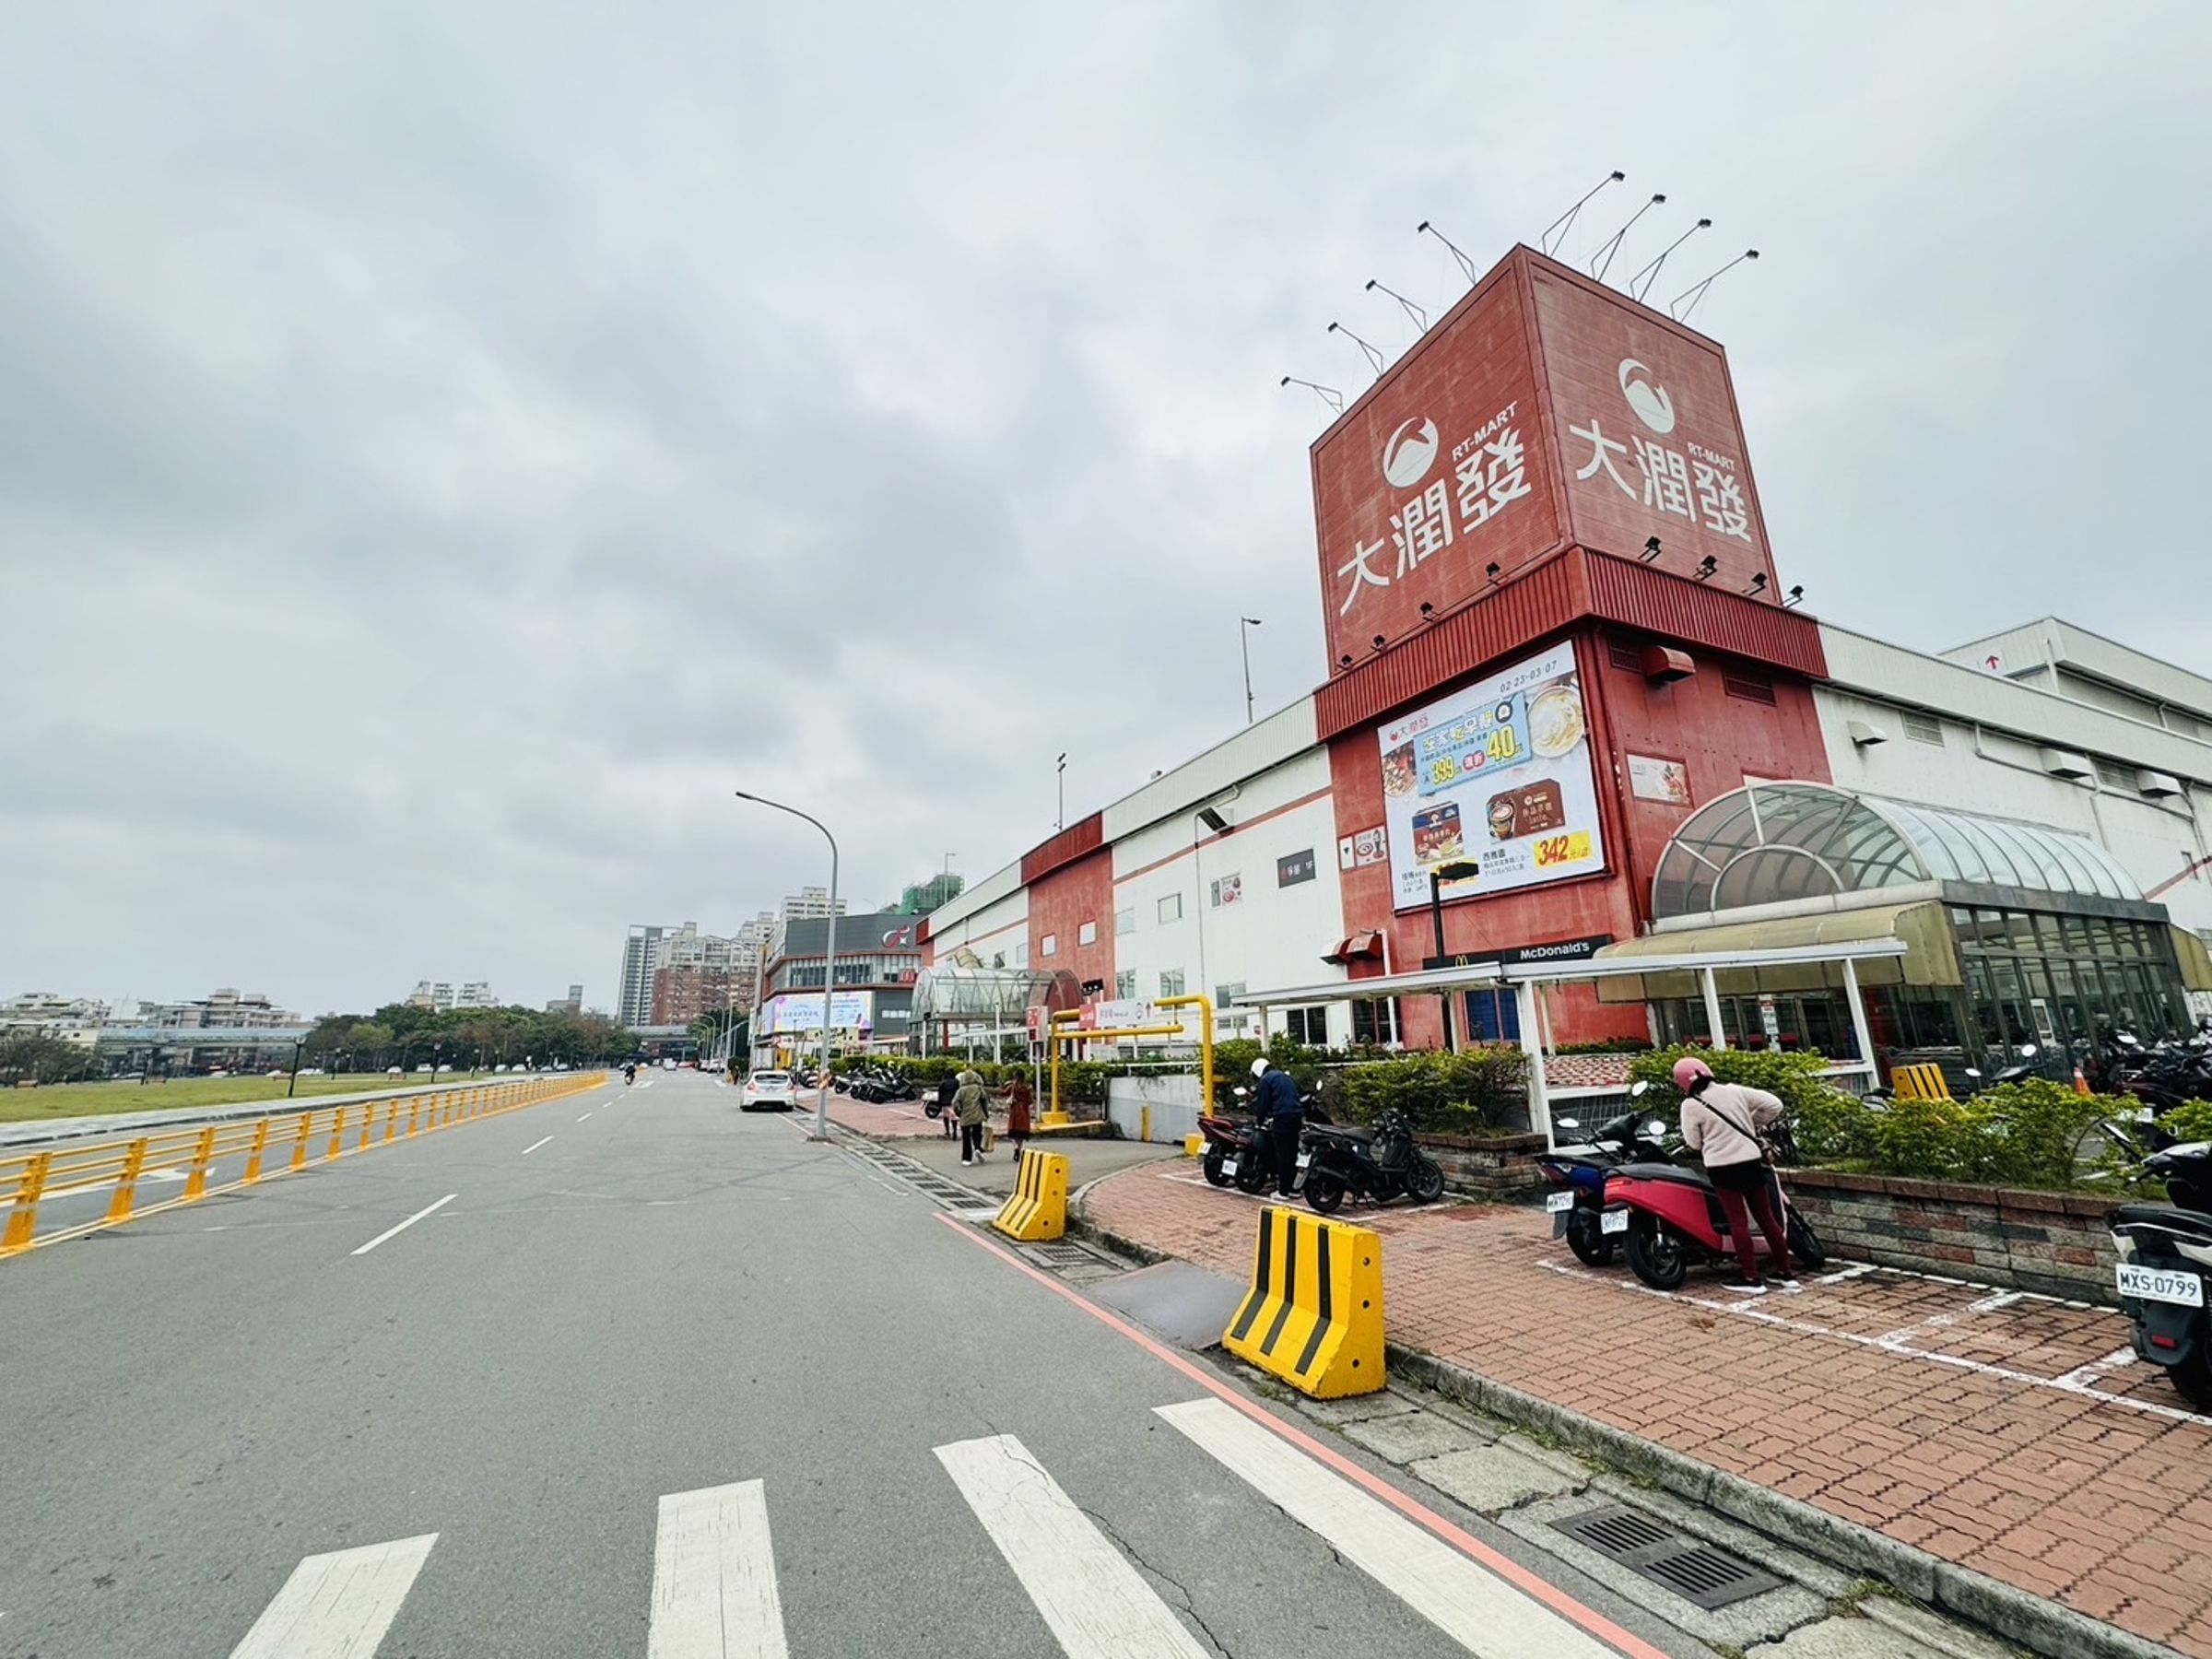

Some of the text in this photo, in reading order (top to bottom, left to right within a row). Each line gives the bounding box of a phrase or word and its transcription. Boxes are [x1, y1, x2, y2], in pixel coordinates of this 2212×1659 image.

[1452, 400, 1517, 462] RT-MART
[1688, 441, 1735, 471] RT-MART
[1569, 418, 1751, 543] 大潤發
[1336, 427, 1532, 617] 大潤發
[1487, 724, 1517, 762] 40
[1430, 754, 1456, 785] 399
[1537, 835, 1569, 865] 342
[1520, 942, 1590, 959] McDonald's
[2120, 1272, 2197, 1298] MXS-0799
